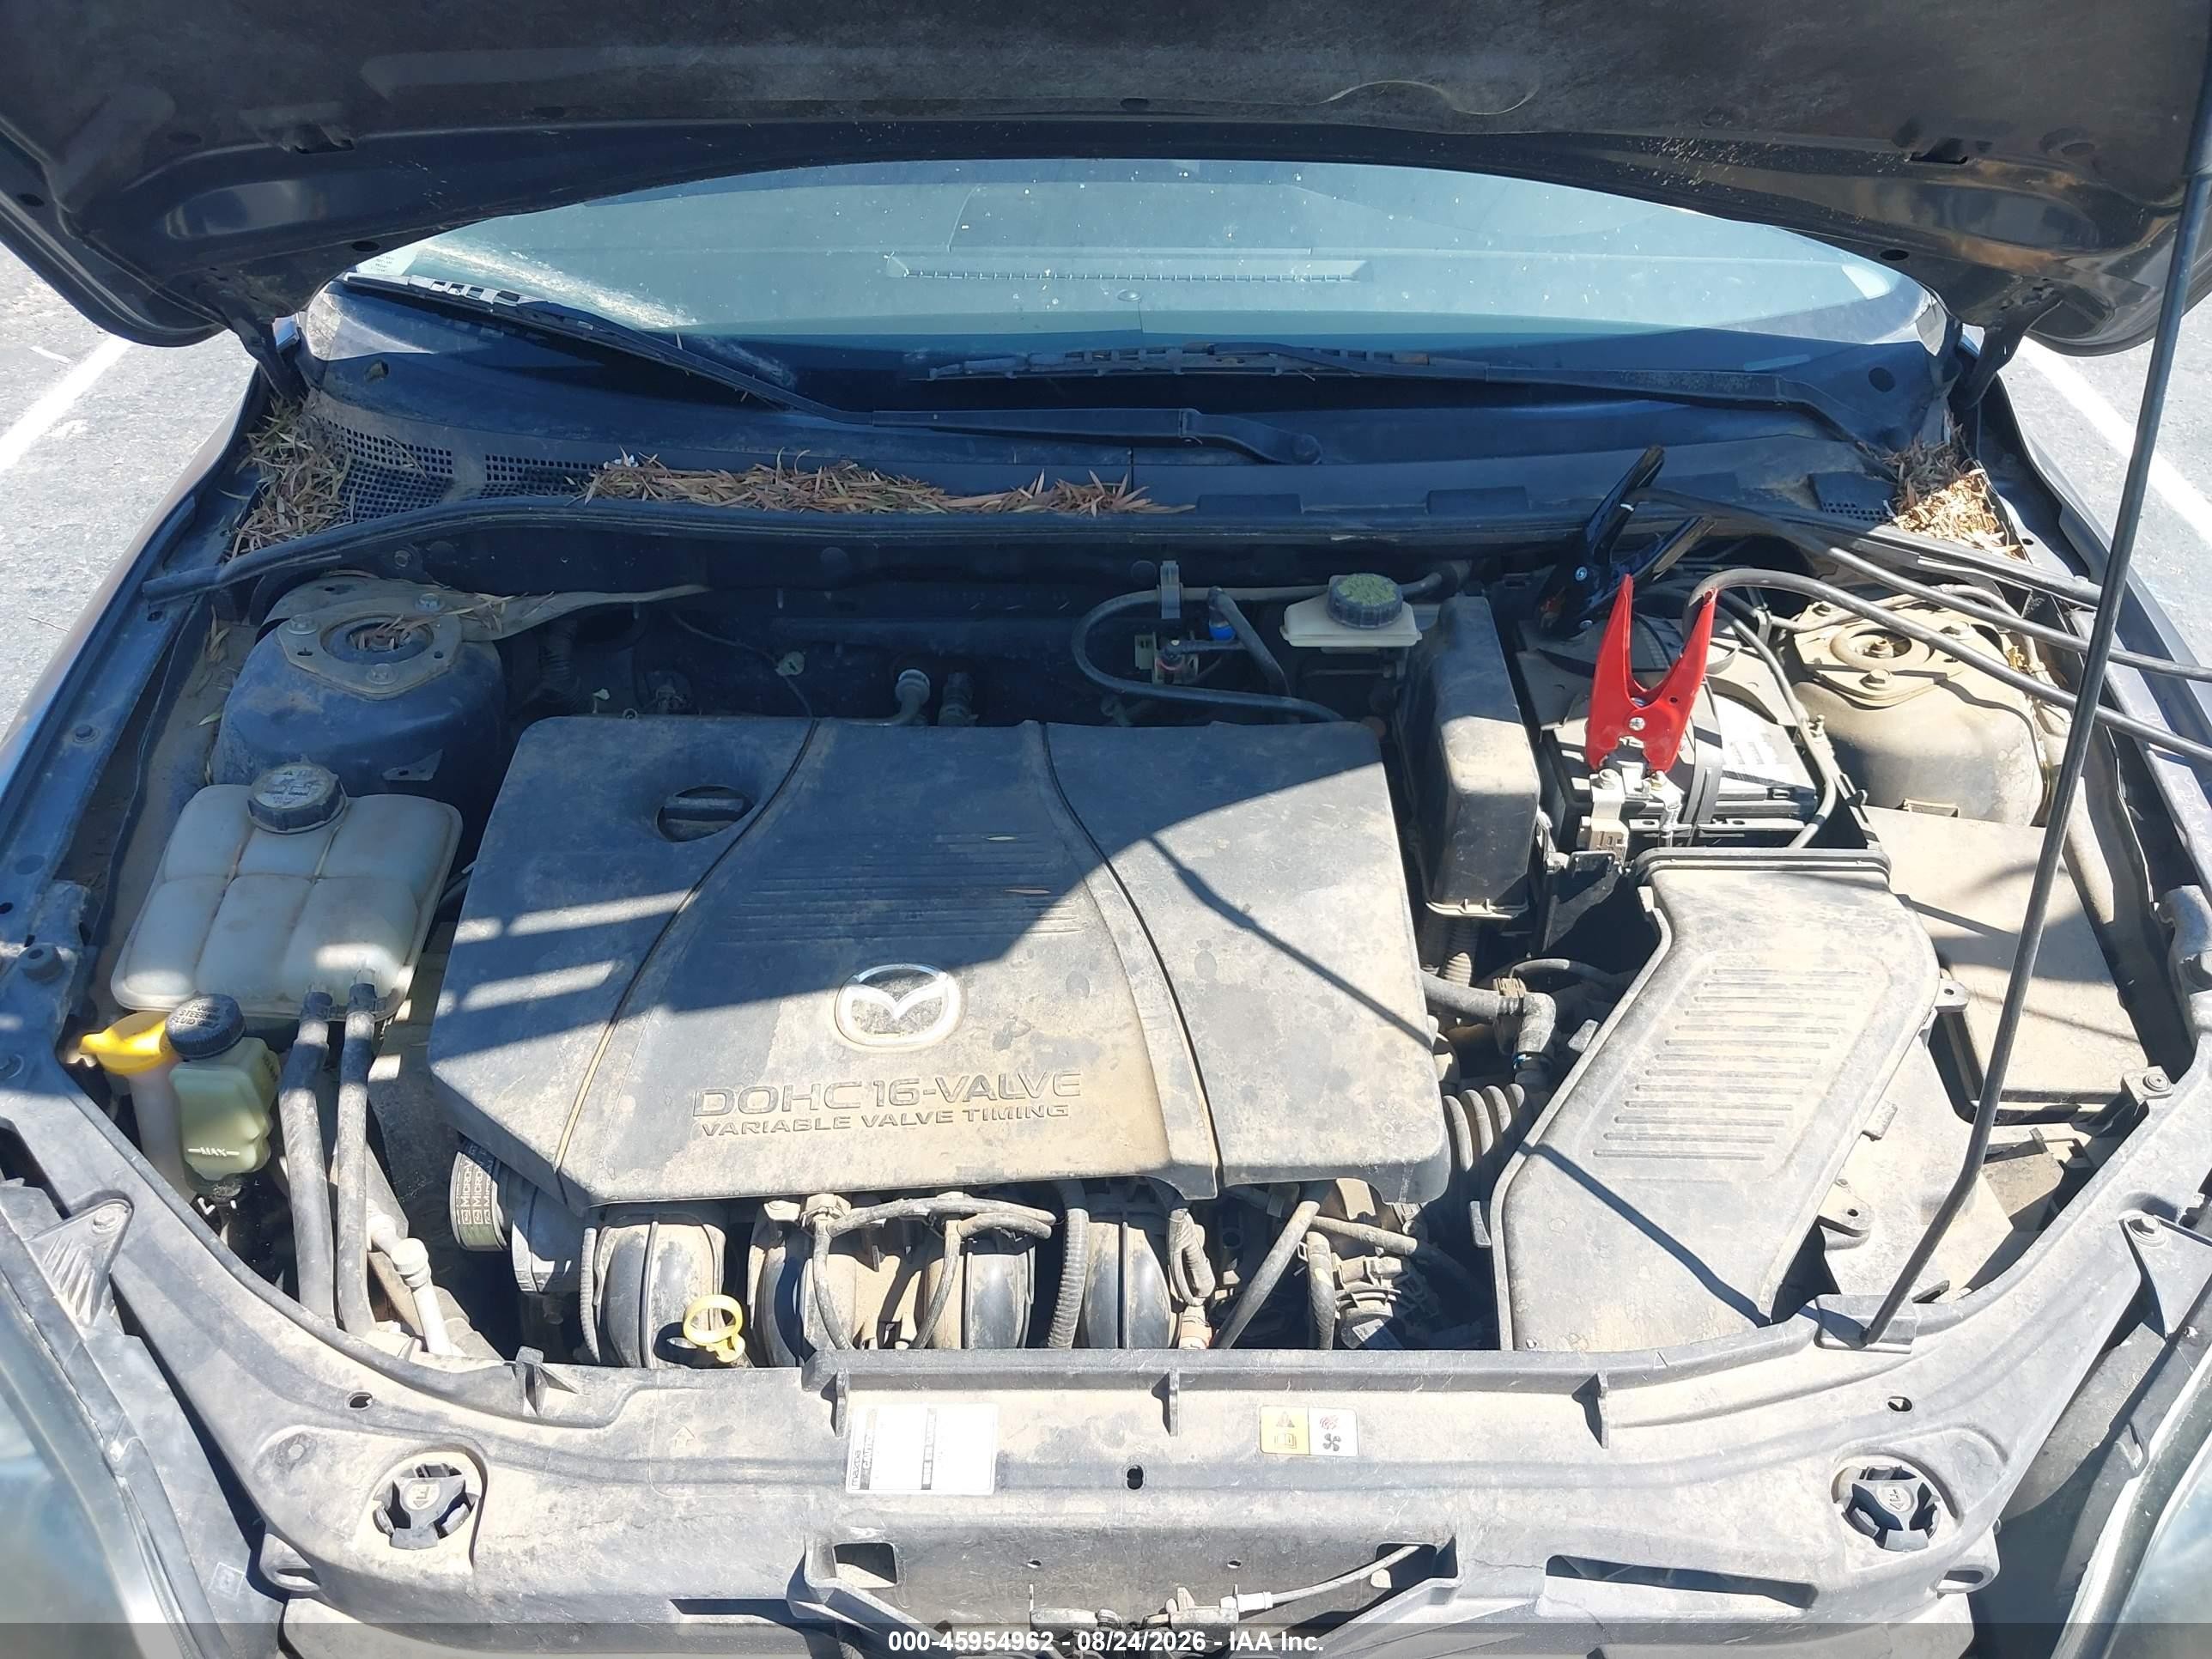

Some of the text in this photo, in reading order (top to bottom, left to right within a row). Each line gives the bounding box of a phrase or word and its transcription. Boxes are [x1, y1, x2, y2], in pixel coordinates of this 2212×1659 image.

[692, 1070, 1082, 1117] DOHC 16-VALVE
[701, 1103, 1070, 1137] VARIABLE VALVE TIMING
[200, 1146, 227, 1157] MAX
[862, 1429, 874, 1469] CAUTIO
